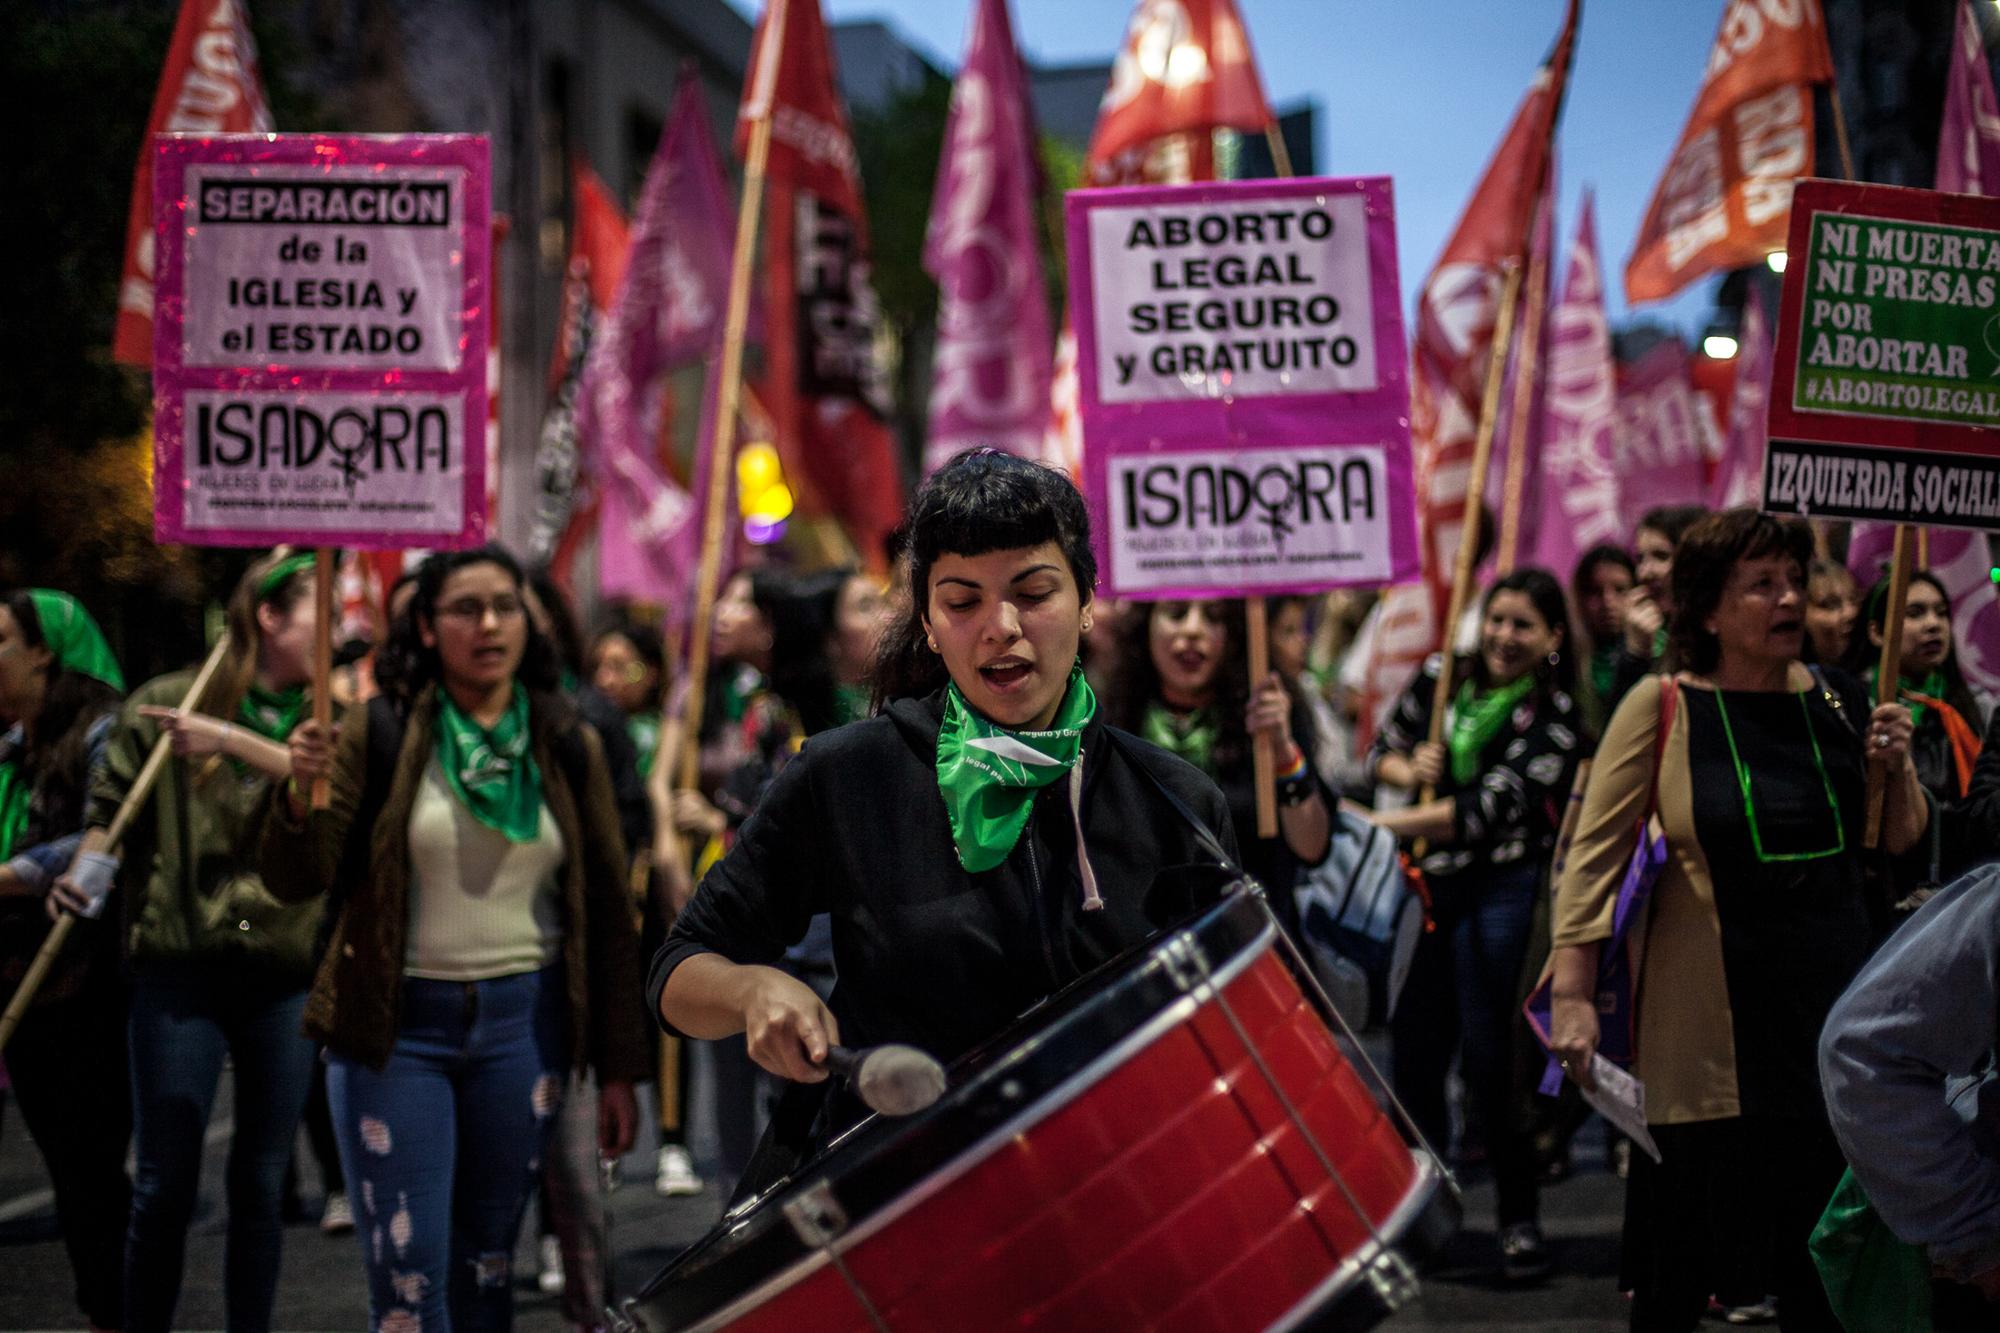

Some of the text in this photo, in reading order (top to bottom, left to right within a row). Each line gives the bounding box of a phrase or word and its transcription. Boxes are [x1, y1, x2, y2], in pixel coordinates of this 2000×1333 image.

[203, 182, 446, 221] SEPARACIÓN
[1126, 209, 1334, 249] ABORTO
[1820, 221, 1860, 257] NI
[279, 236, 367, 262] de la
[1152, 253, 1314, 290] LEGAL
[1816, 259, 1996, 308] NI PRESAS
[228, 278, 418, 315] IGLESIA y
[1130, 295, 1340, 334] SEGURO
[1812, 300, 1873, 332] POR
[221, 324, 422, 353] el ESTADO
[1808, 332, 1970, 380] ABORTAR
[1115, 336, 1358, 385] y GRATUITO
[198, 402, 450, 496] ISADORA
[1769, 451, 1907, 517] IZQUIERDA
[1122, 456, 1376, 554] ISADORA
